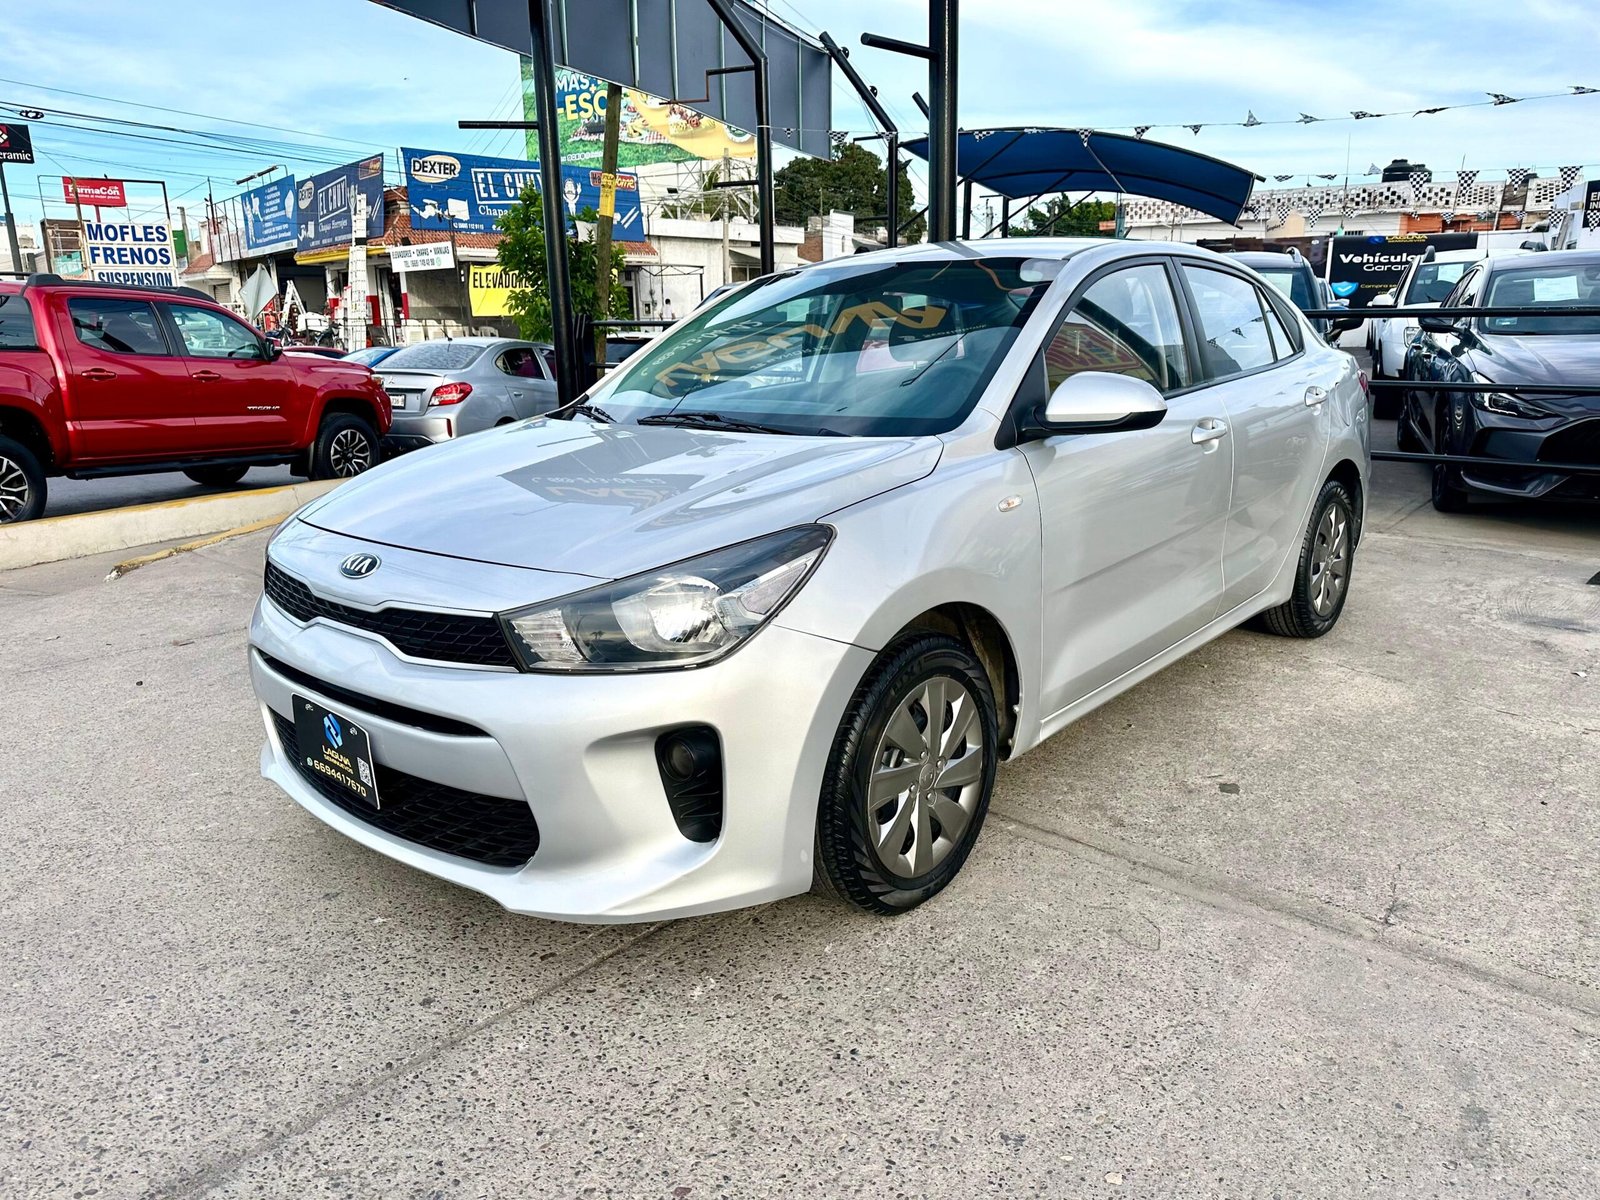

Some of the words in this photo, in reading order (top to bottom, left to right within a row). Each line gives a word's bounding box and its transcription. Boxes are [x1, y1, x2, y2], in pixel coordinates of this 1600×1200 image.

[412, 159, 457, 176] DEXTER
[476, 172, 499, 198] EL
[503, 172, 542, 198] CHU
[319, 191, 327, 216] EL
[328, 180, 345, 212] CHUY
[86, 223, 168, 242] MOFLES
[1385, 233, 1428, 241] LAGUNA
[89, 246, 171, 265] FRENOS
[97, 271, 173, 287] SUSPENSION
[473, 271, 533, 289] ELEVADOE
[342, 555, 373, 574] KIA
[322, 744, 352, 768] LAGUNA
[313, 759, 367, 798] 6694417670
